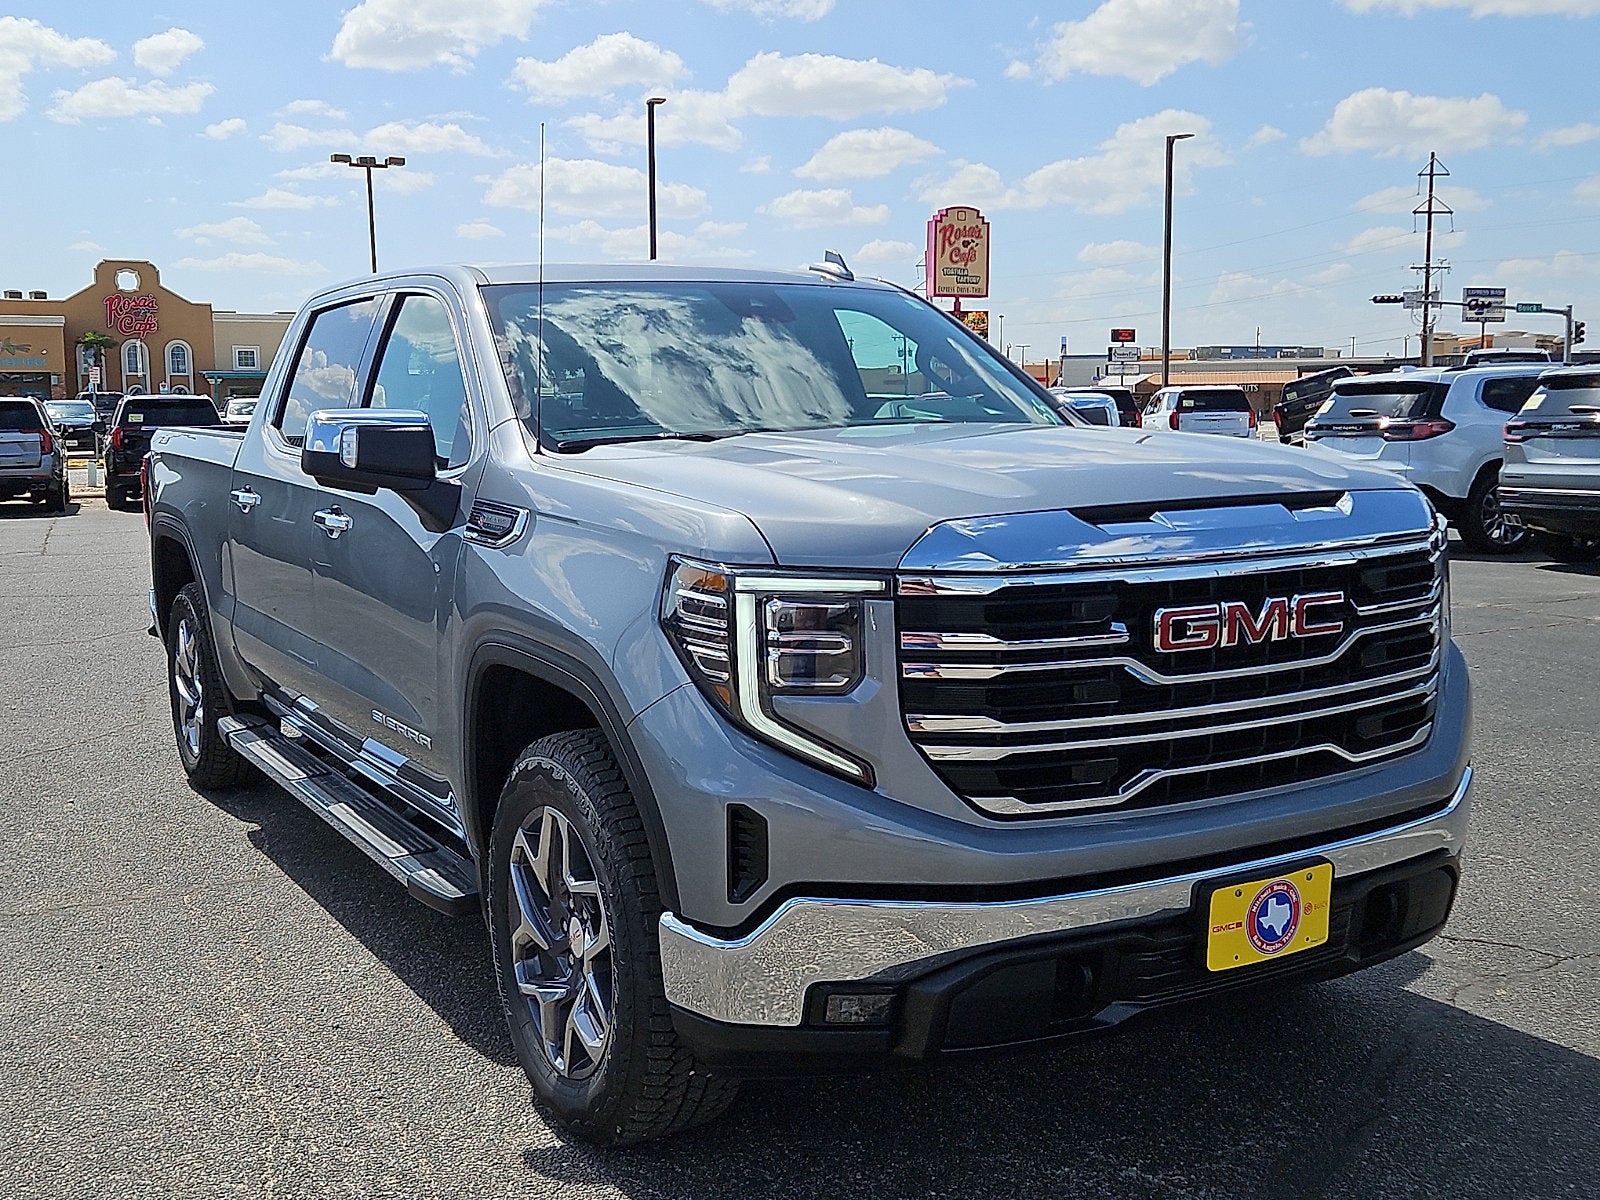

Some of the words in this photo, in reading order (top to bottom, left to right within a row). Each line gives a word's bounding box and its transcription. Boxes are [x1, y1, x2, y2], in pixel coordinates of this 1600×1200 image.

[939, 224, 983, 258] Rosa's
[103, 293, 159, 328] Rosa's
[1153, 591, 1345, 653] GMC
[371, 709, 433, 750] SIERRA
[1212, 922, 1237, 933] GMC
